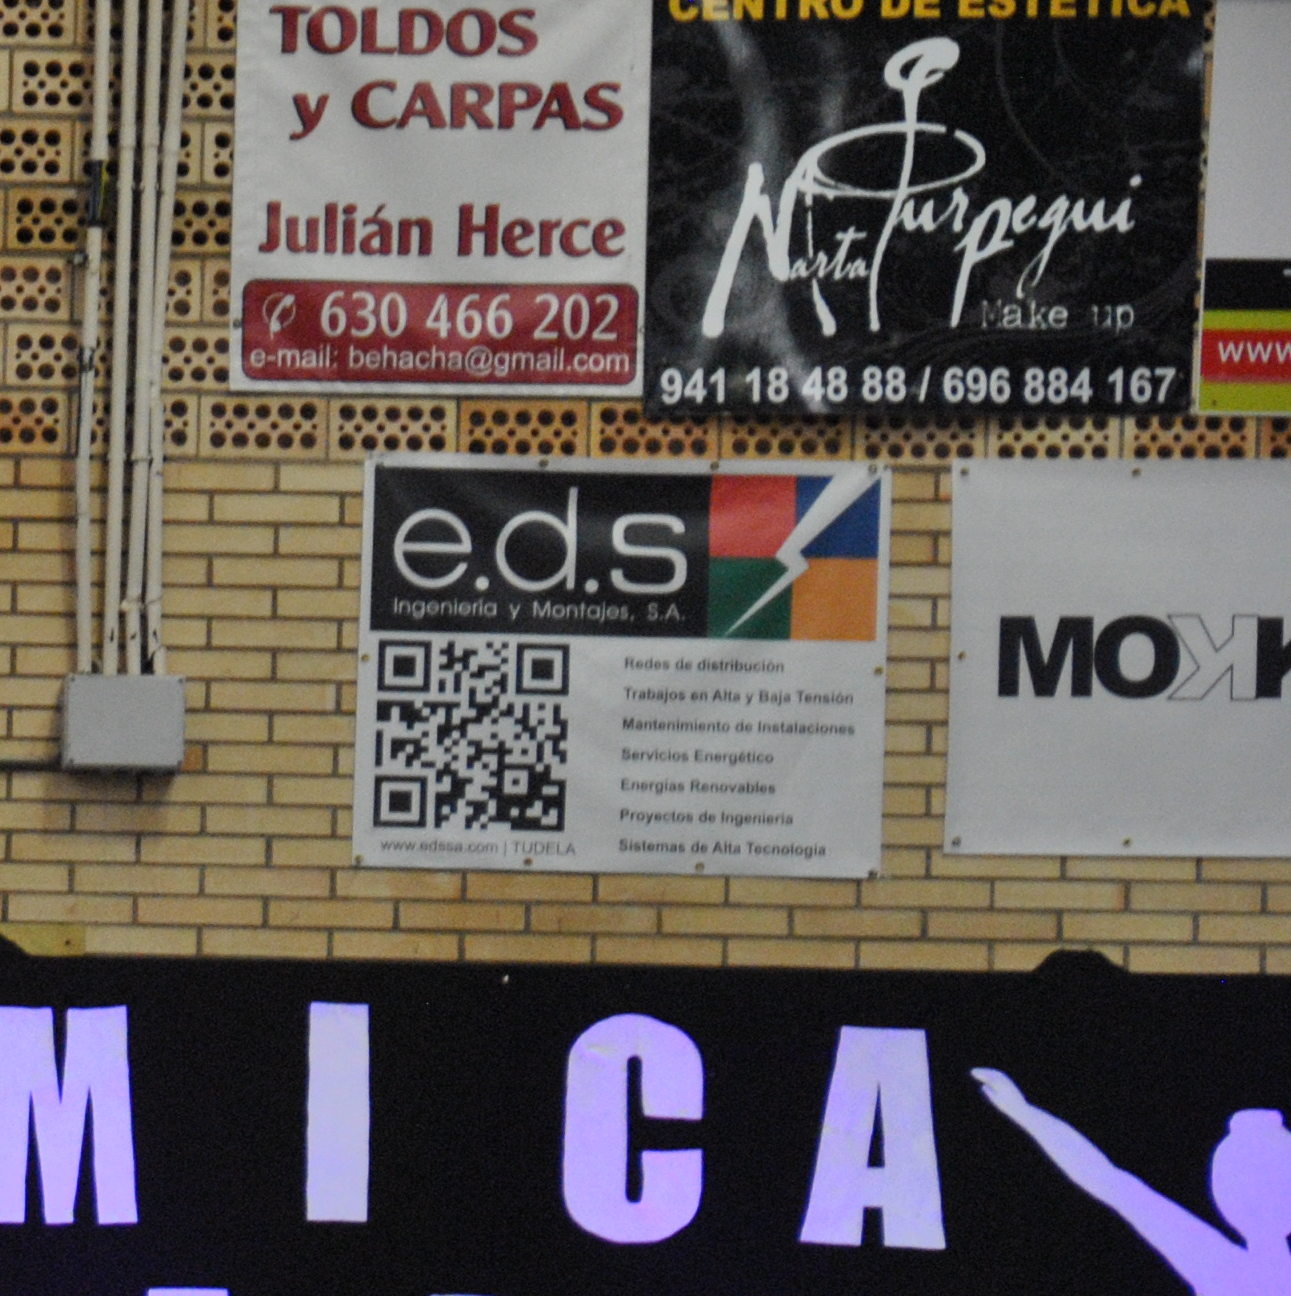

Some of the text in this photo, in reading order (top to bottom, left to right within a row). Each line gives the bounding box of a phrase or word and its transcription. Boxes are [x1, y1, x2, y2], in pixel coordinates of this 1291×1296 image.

[668, 0, 865, 22] CENTRO
[881, 0, 941, 19] DE
[269, 5, 540, 58] TOLDOS
[288, 79, 625, 141] y CARPAS
[258, 200, 627, 259] Julián Herce
[320, 291, 619, 341] 630 466 202
[981, 299, 1136, 336] Make up
[250, 345, 630, 376] e-mail: behacha@gmail.com
[659, 366, 1177, 404] 941 18 48 88 / 696 884 167
[393, 486, 688, 595] e.d.s
[509, 601, 521, 621] y
[647, 602, 686, 623] S.A.
[624, 656, 785, 674] Redes de distribución
[624, 686, 686, 704] Trabajos
[690, 690, 708, 702] en
[713, 688, 741, 702] Alta
[745, 692, 755, 705] y
[759, 689, 791, 706] Baja
[622, 717, 856, 736] Mantenimiento de Instalaciones
[621, 748, 690, 763] Servicios
[690, 778, 777, 795] Renovables
[619, 807, 694, 825] Proyectos
[698, 809, 716, 824] de
[513, 840, 576, 856] TUDELA
[618, 837, 686, 854] Sistemas
[690, 839, 708, 854] de
[712, 840, 741, 856] Alta
